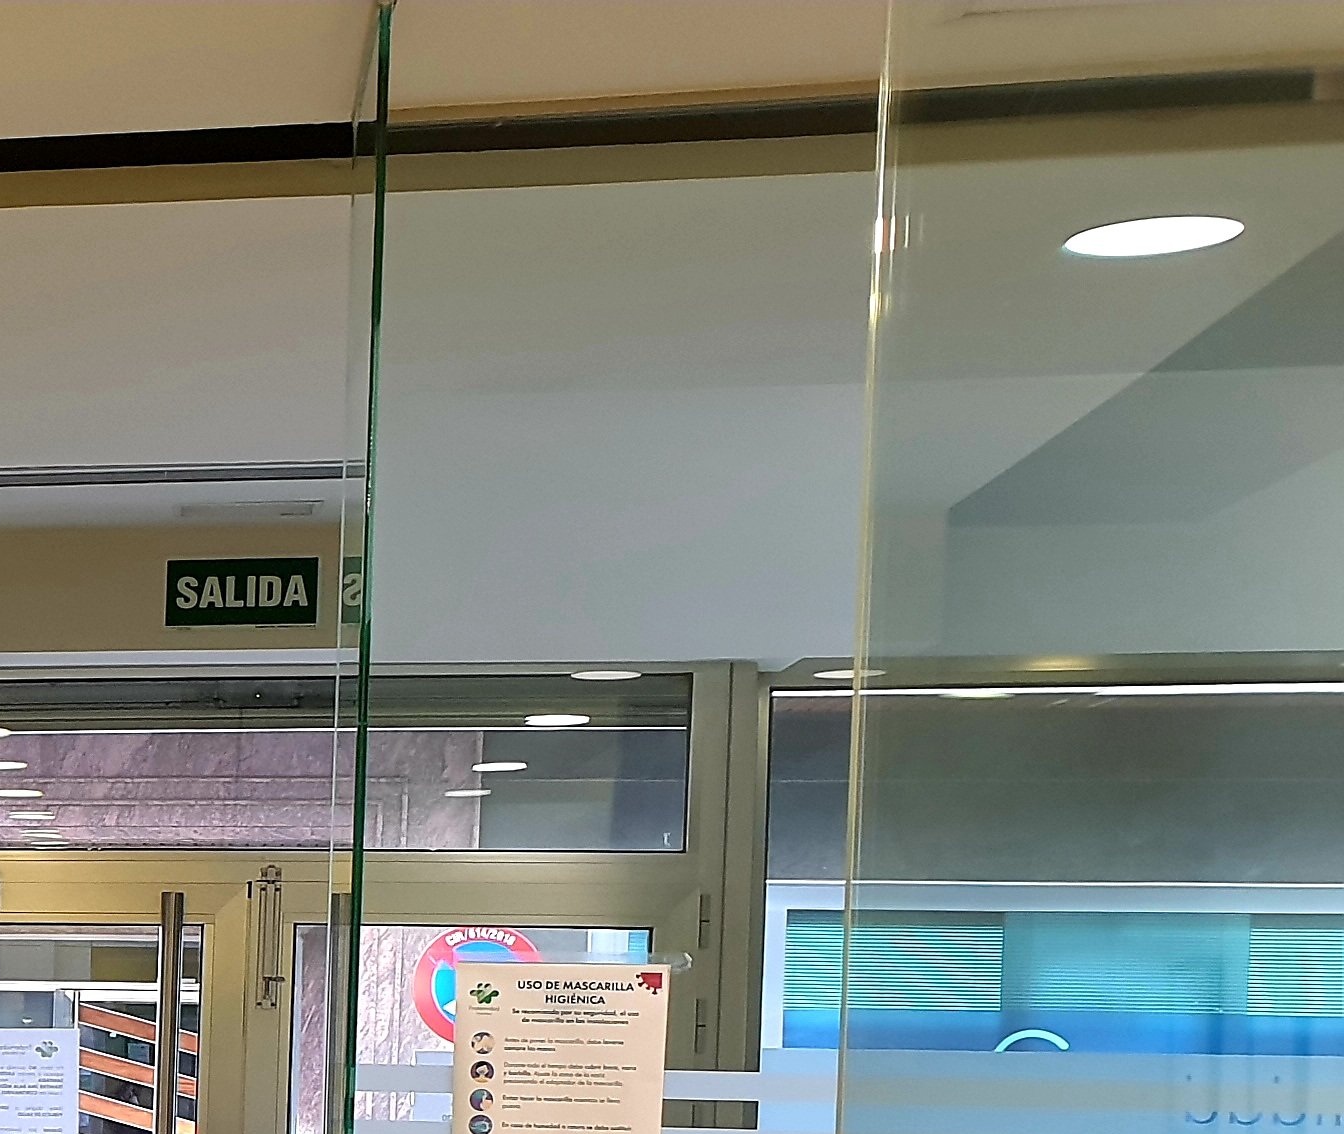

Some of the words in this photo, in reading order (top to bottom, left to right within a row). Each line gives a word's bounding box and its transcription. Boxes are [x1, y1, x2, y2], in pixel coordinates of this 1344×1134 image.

[176, 575, 308, 609] SALIDA
[517, 980, 542, 990] USO
[546, 981, 559, 990] DE
[563, 981, 634, 991] MASCARILLA
[545, 994, 606, 1004] HIGIÉNICA
